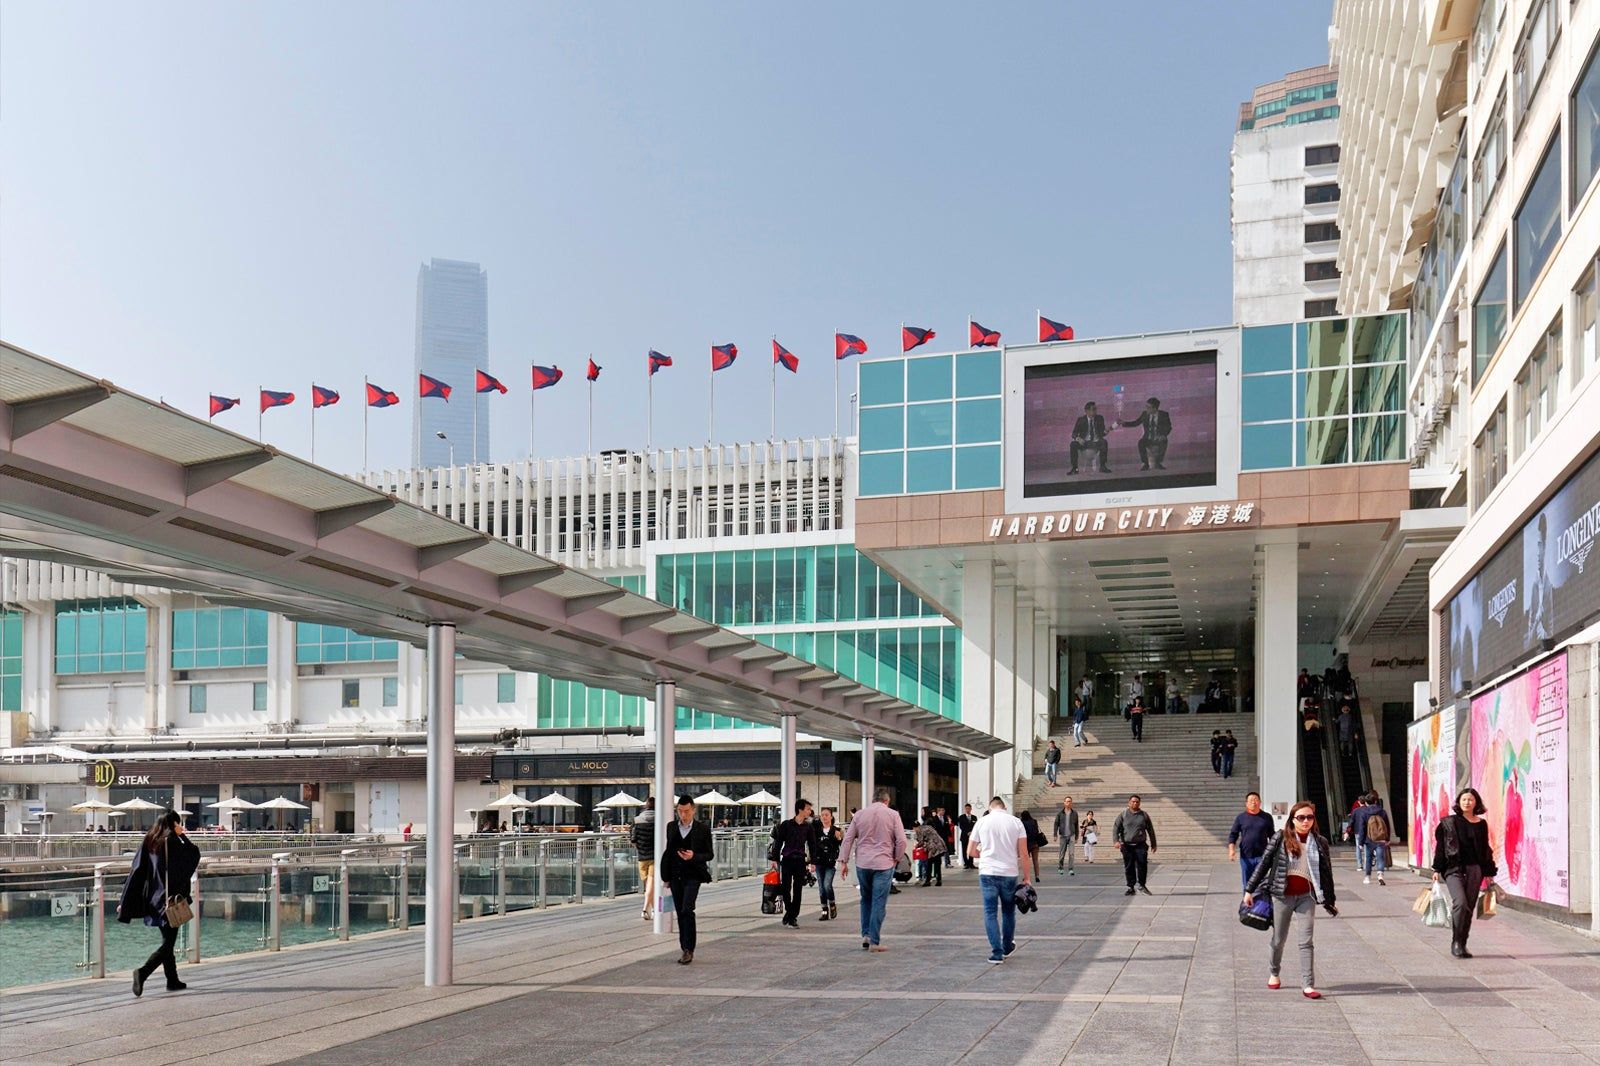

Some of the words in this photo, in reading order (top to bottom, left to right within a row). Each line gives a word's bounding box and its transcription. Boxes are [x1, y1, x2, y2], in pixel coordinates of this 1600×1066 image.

[989, 511, 1107, 537] HARBOUR
[1118, 507, 1173, 530] CITY
[1184, 503, 1255, 526] 海港城
[1488, 578, 1517, 620] LONGINES
[95, 765, 110, 783] BLT
[118, 775, 150, 785] STEAK
